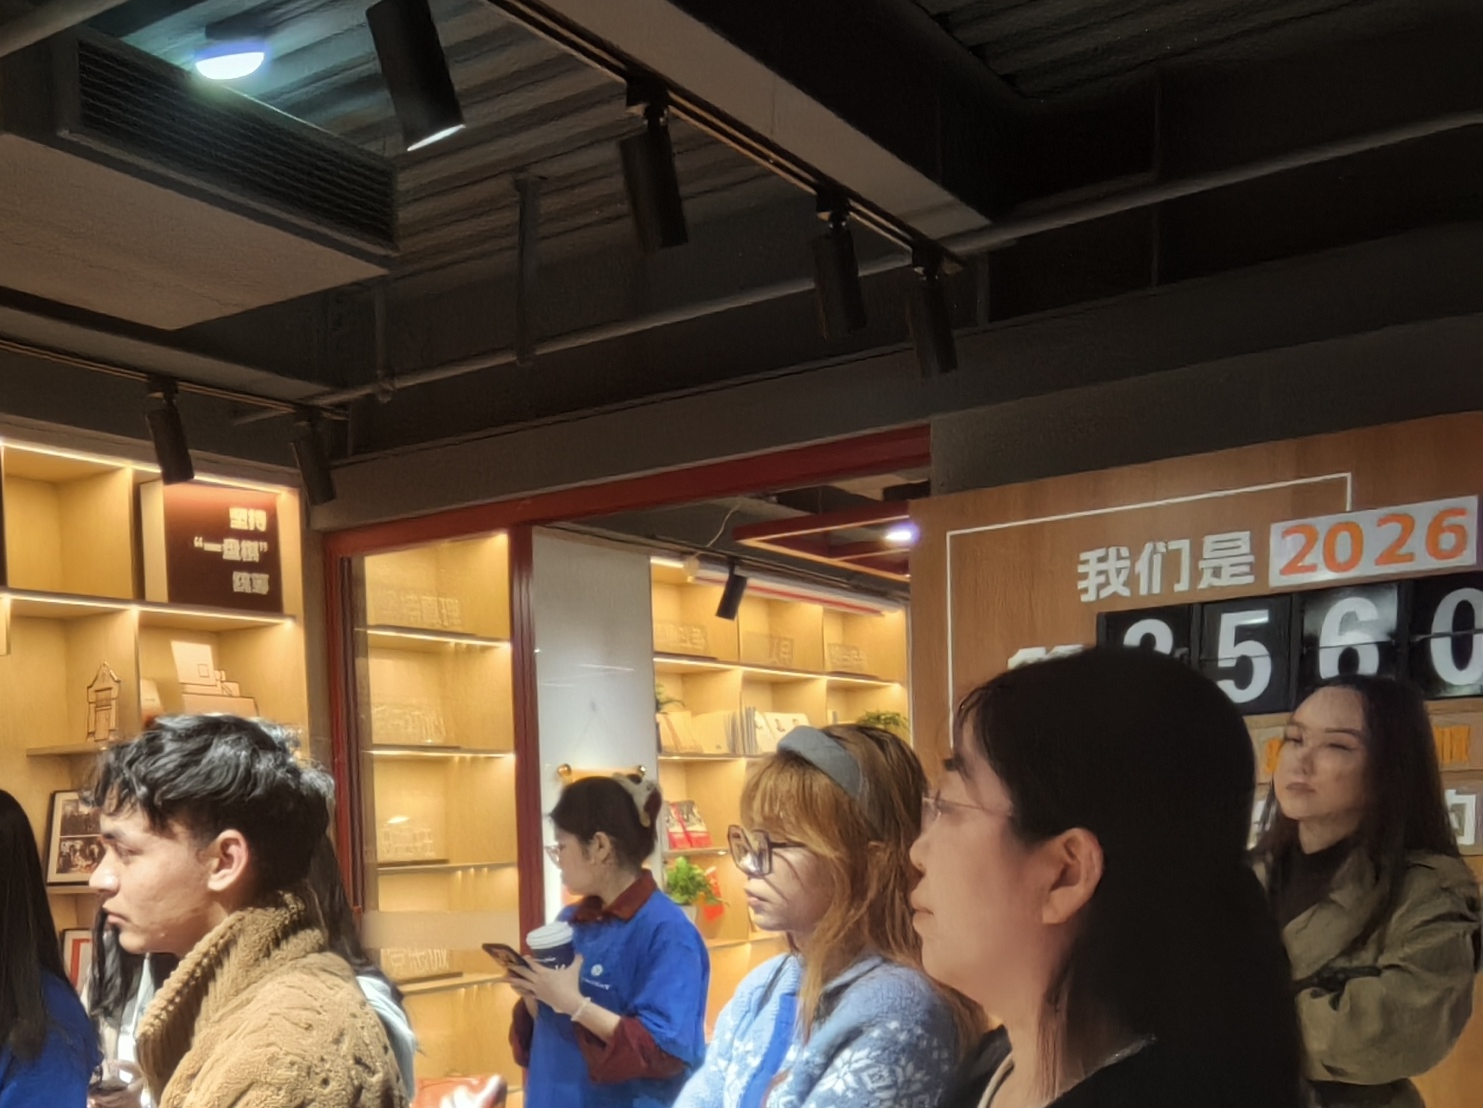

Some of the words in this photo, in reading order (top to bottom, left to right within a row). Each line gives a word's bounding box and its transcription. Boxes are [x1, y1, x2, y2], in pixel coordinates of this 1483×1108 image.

[1077, 530, 1256, 602] 我们是
[1278, 507, 1468, 578] 2026
